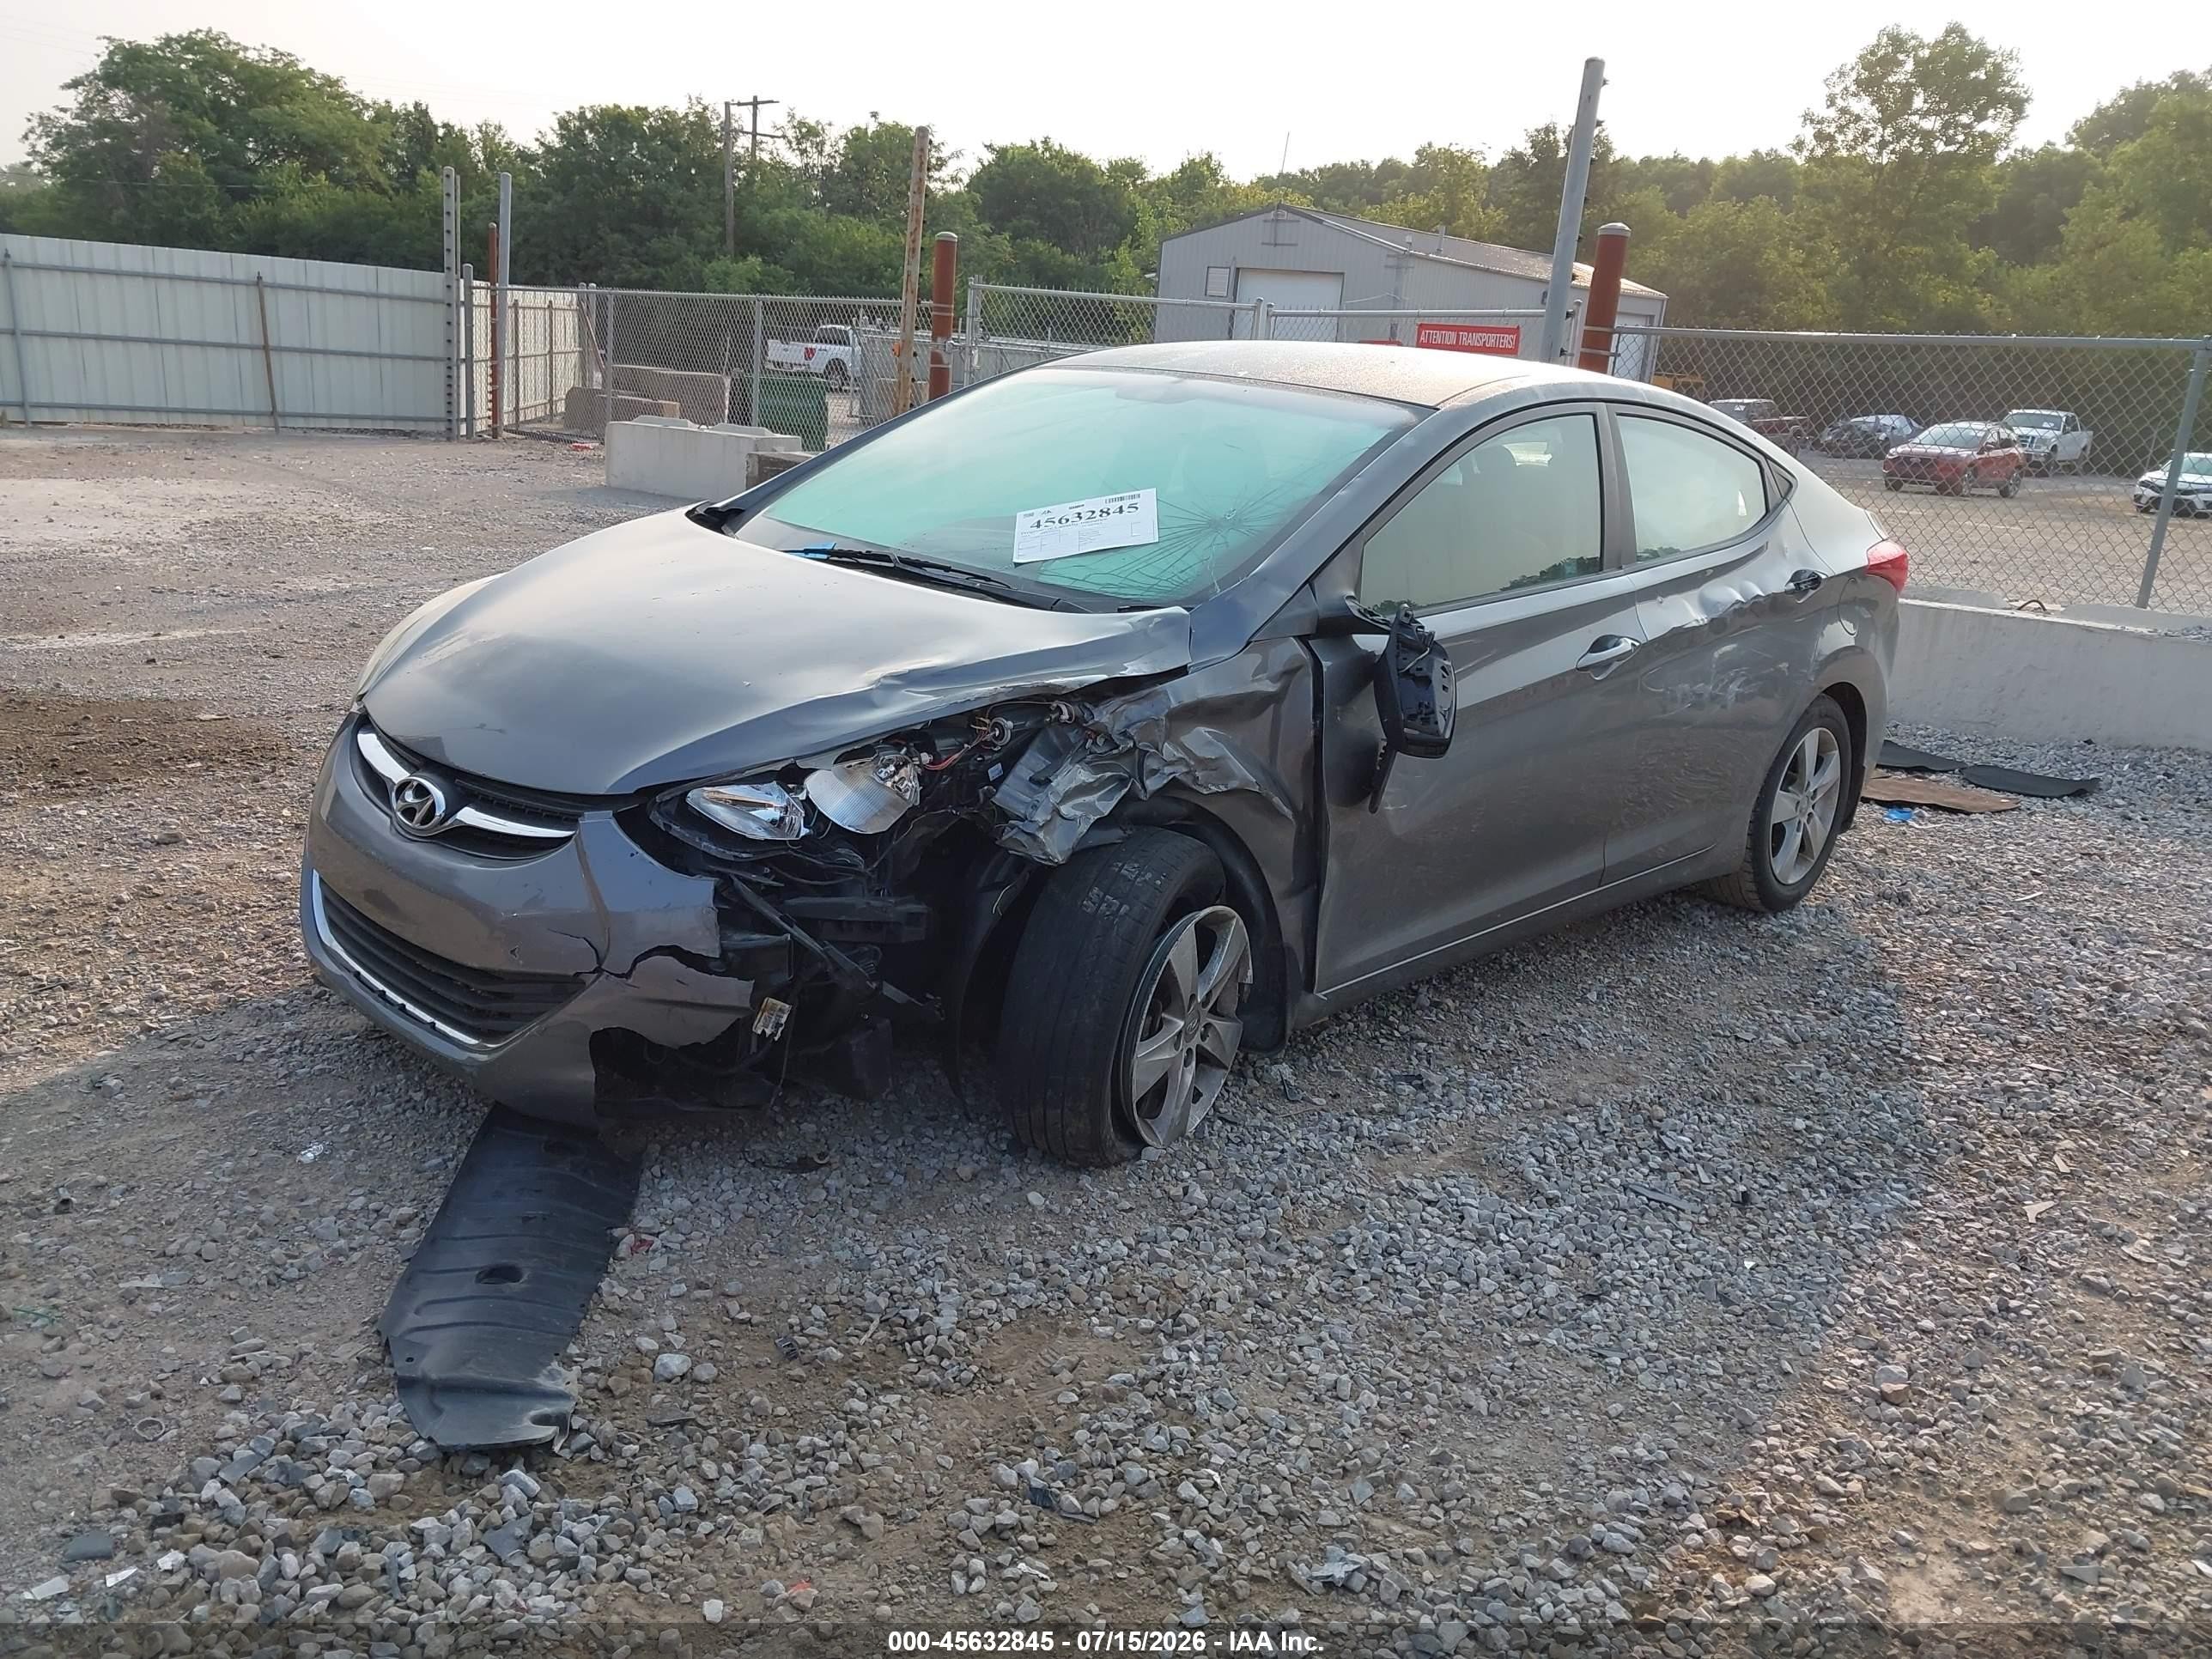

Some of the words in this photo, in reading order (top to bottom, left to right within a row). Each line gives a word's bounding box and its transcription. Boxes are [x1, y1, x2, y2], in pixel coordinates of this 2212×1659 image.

[1419, 330, 1456, 345] ATTENTION
[1459, 331, 1516, 349] TRANSPORTERS!
[1030, 502, 1139, 529] 45632845
